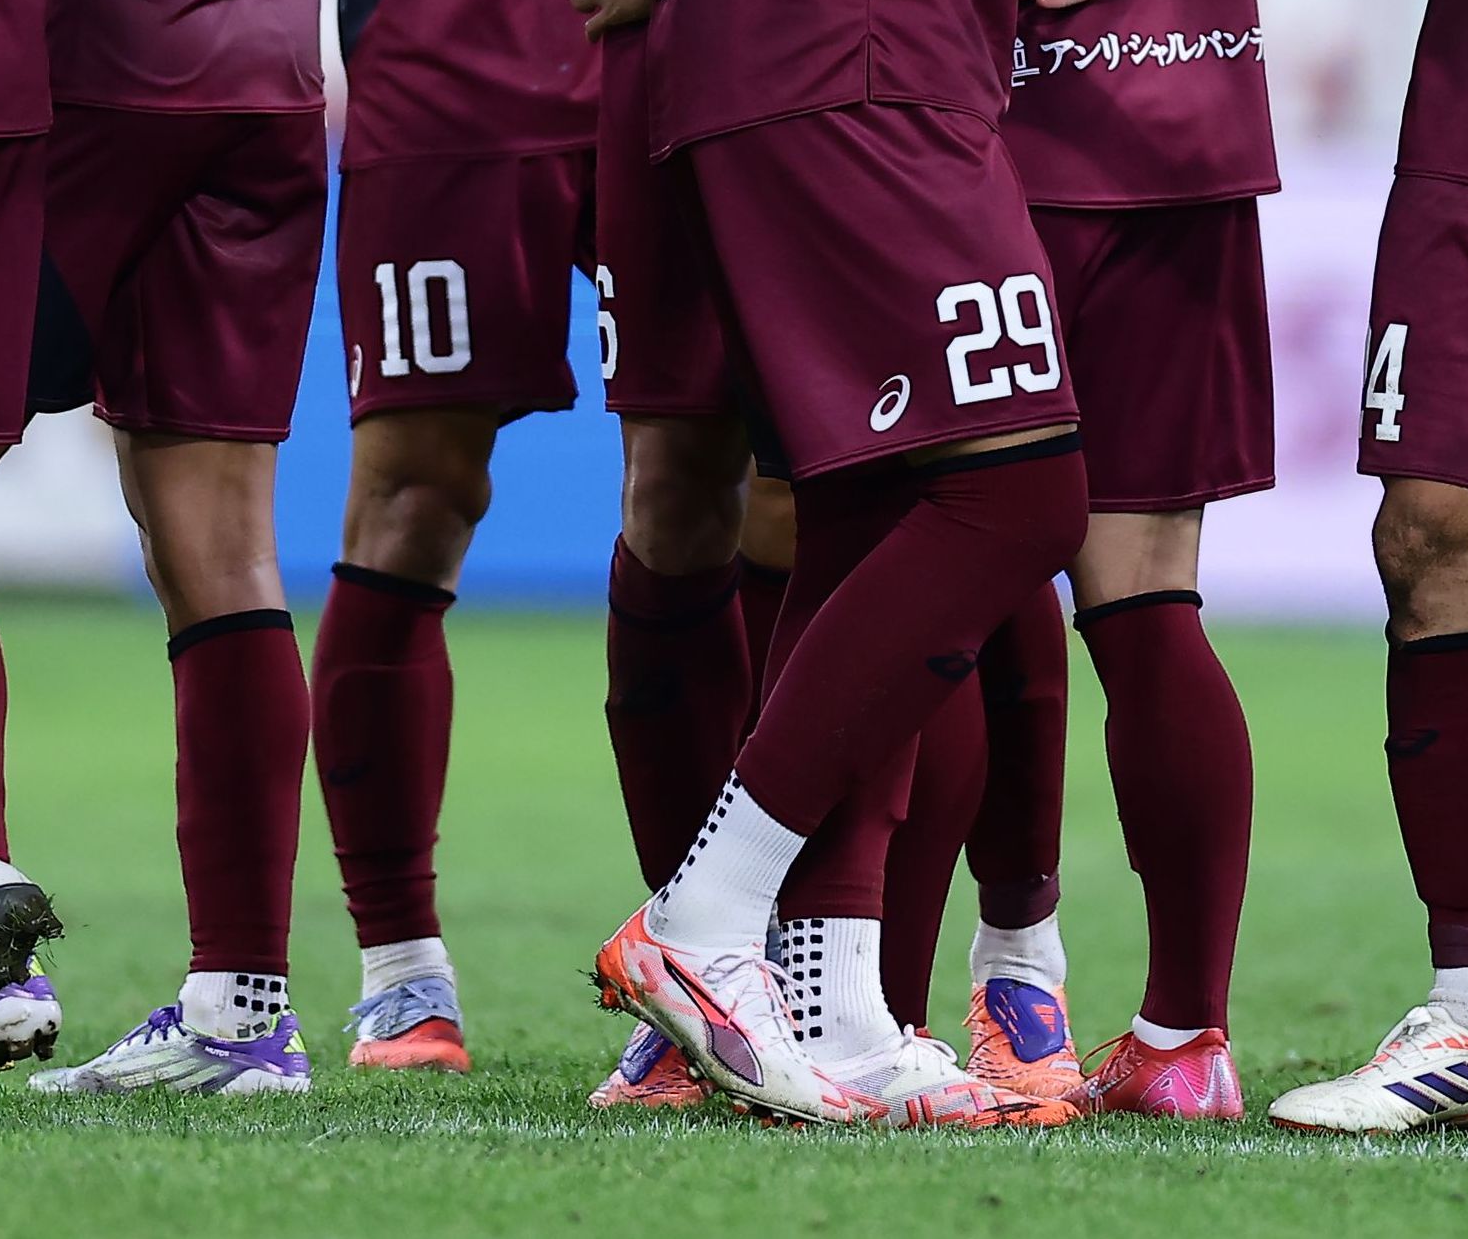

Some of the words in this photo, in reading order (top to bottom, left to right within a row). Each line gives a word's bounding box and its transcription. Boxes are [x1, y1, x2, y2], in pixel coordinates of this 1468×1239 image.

[374, 259, 470, 377] 10
[936, 272, 1061, 405] 29
[1359, 323, 1408, 442] 4
